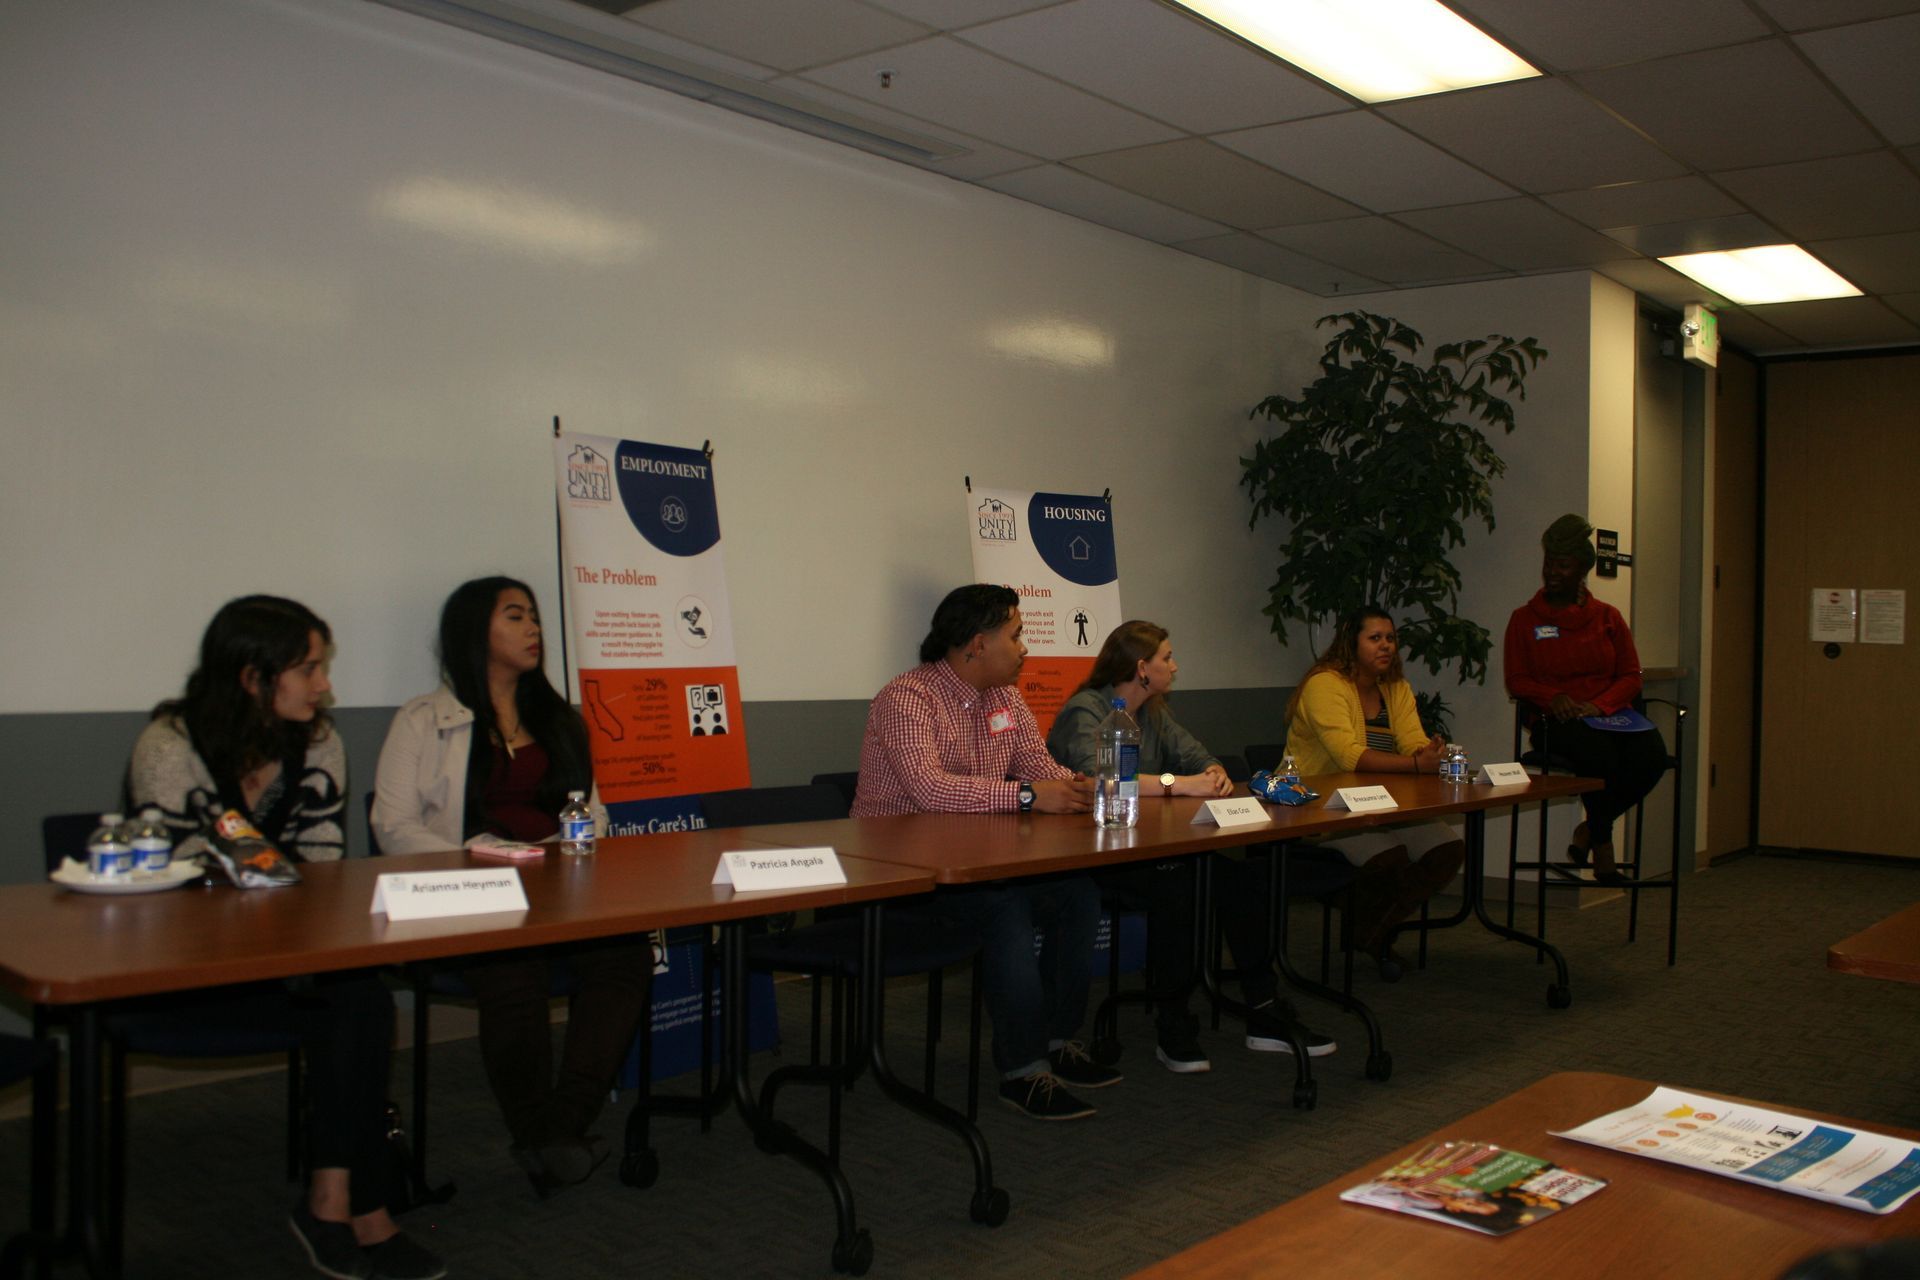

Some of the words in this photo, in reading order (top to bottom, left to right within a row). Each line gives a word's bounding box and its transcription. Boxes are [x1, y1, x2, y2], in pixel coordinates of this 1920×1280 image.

[621, 455, 707, 479] EMPLOYMENT
[568, 470, 607, 485] UNITY
[568, 481, 608, 499] CARE
[1044, 506, 1106, 522] HOUSING
[979, 518, 1014, 530] UNITY
[979, 528, 1013, 540] CARE
[575, 566, 598, 584] The
[601, 568, 656, 586] Problem
[1025, 610, 1042, 618] youth
[1043, 619, 1054, 627] and
[645, 678, 668, 691] 29%
[642, 761, 665, 775] 50%
[608, 822, 645, 838] Unity
[647, 814, 688, 834] Care's
[750, 859, 788, 870] Patricia
[412, 883, 459, 893] Arianna
[462, 880, 512, 891] Heyman
